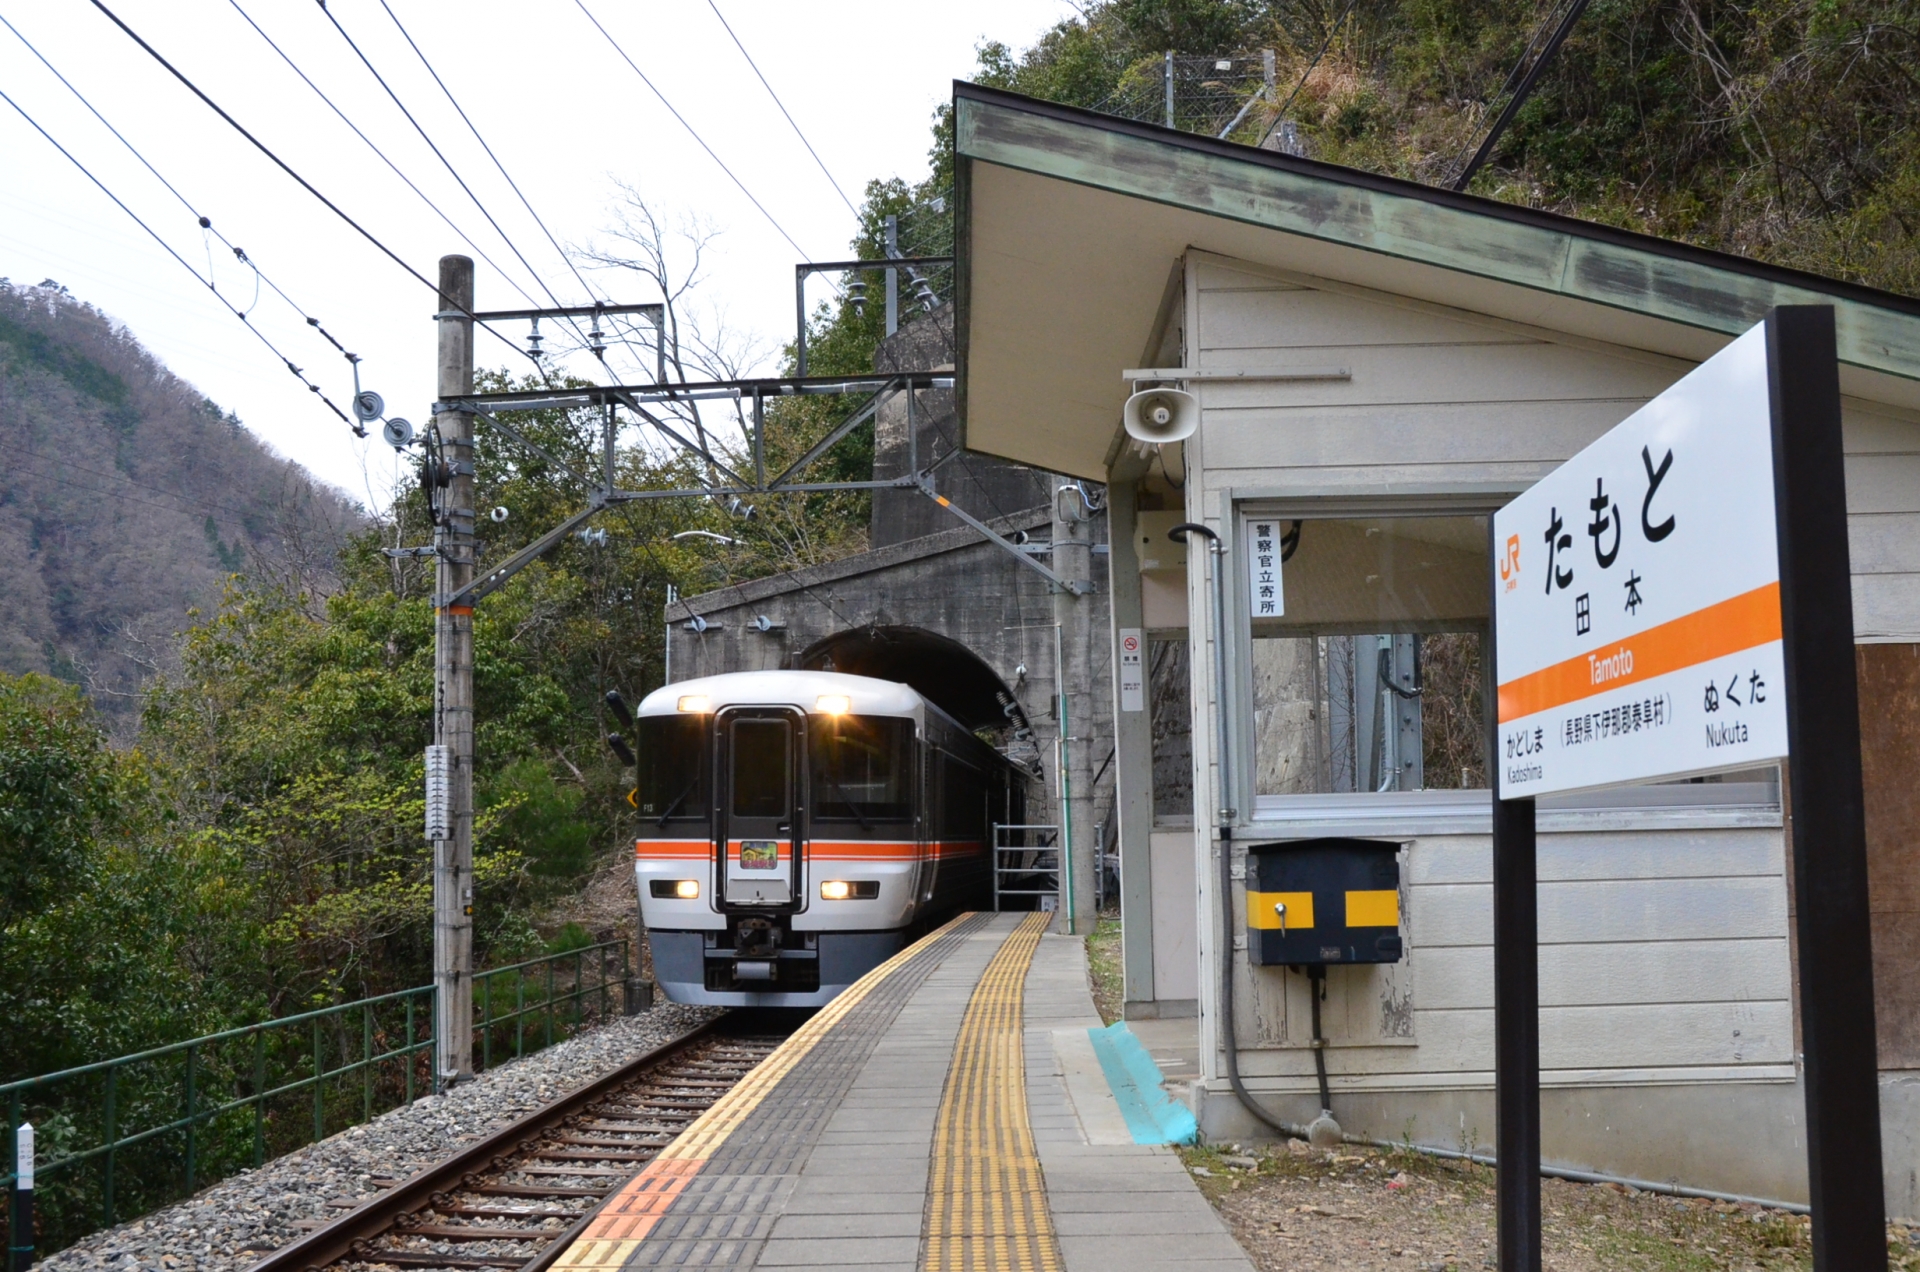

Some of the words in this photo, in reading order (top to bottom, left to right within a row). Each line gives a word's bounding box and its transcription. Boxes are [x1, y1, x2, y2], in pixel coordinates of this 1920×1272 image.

[1544, 444, 1676, 596] たもと
[1256, 524, 1275, 613] 警察官立寄所
[1500, 533, 1520, 580] JR
[1576, 569, 1642, 636] 田本
[1588, 647, 1633, 685] Tamoto
[1704, 669, 1766, 713] ぬくた
[1507, 725, 1543, 759] かどしま
[1706, 720, 1748, 748] Nukuta
[1507, 762, 1542, 785] Kadoshima
